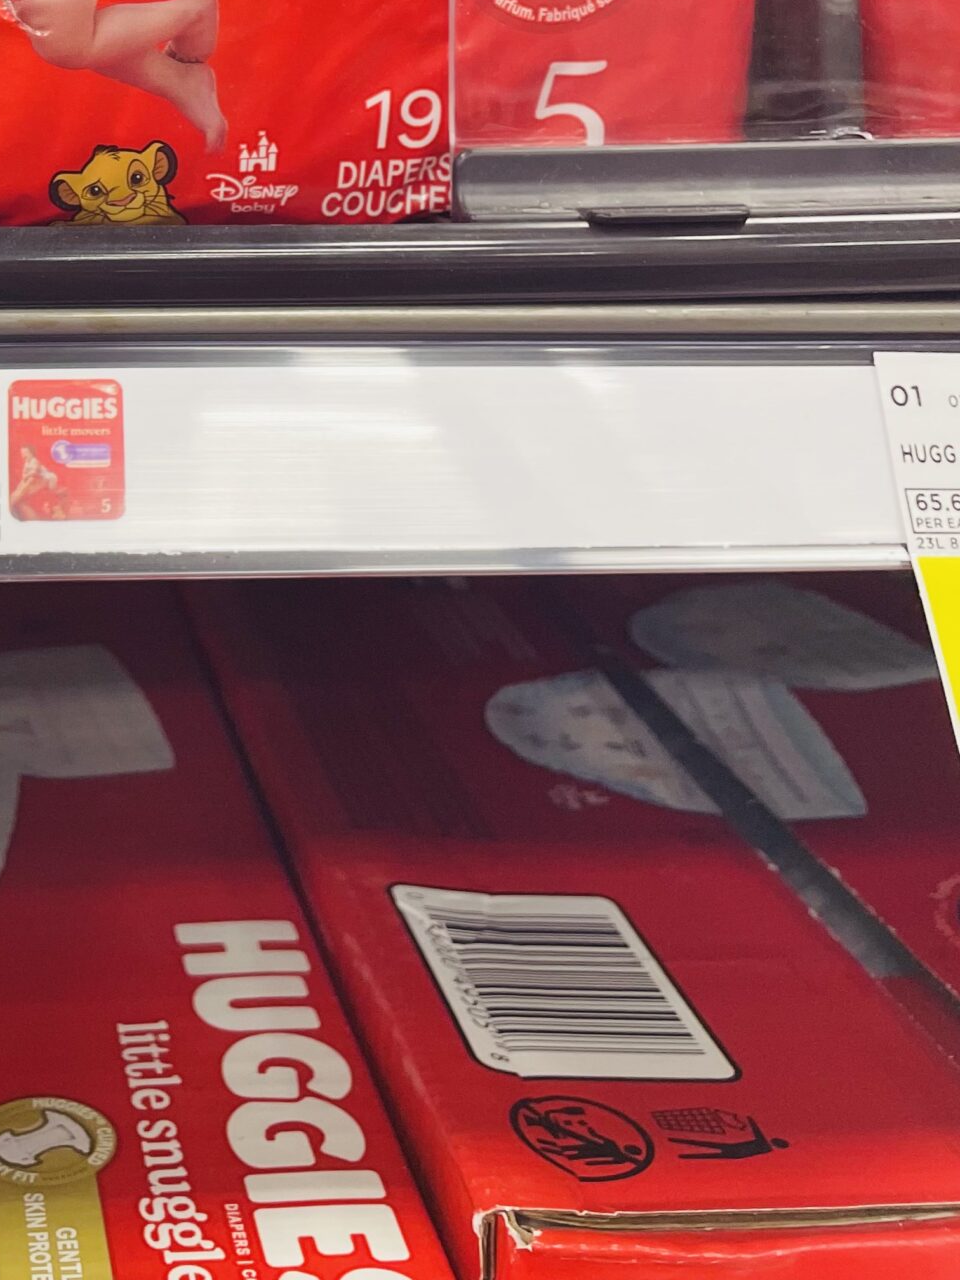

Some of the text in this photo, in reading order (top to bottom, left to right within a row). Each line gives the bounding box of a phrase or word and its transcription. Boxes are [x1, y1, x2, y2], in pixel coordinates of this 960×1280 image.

[538, 1, 595, 23] Fabriqué
[365, 89, 442, 149] 19
[534, 60, 608, 145] 5
[336, 156, 451, 190] DIAPERS
[231, 201, 275, 213] baby
[12, 396, 117, 420] HUGGIES
[901, 444, 956, 463] HUGG
[101, 499, 111, 513] 5
[916, 517, 944, 529] PER
[116, 1020, 182, 1111] little
[173, 920, 411, 1280] HUGGIE
[23, 1193, 47, 1228] SKIN
[224, 1203, 251, 1257] DIAPERS
